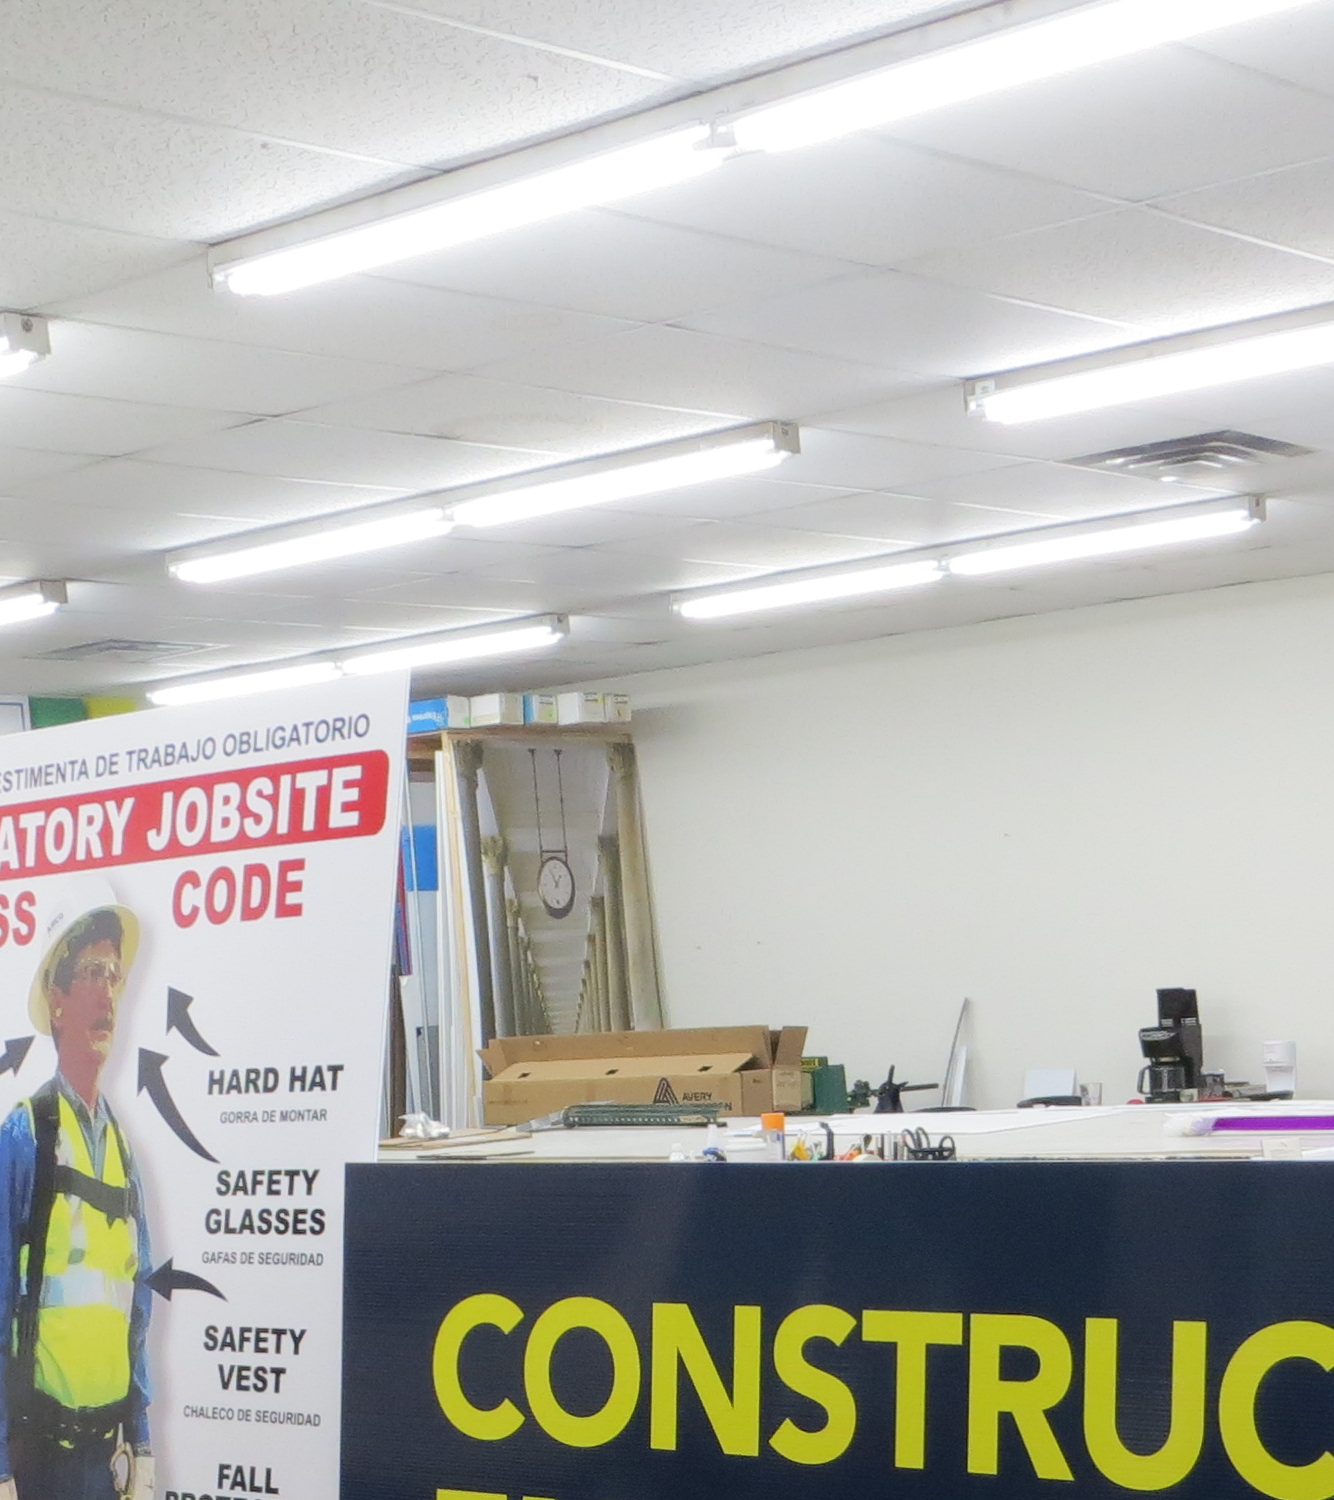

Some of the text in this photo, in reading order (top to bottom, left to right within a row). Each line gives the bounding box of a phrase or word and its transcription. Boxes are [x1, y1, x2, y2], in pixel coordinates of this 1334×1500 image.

[94, 753, 122, 778] DE
[124, 737, 218, 773] TRABAJO
[222, 713, 371, 757] OBLIGATORIO
[146, 764, 364, 853] JOBSITE
[171, 857, 307, 930] CODE
[207, 1064, 345, 1096] HARD HAT
[219, 1108, 328, 1125] GORRA DE MONTAR
[216, 1169, 321, 1197] SAFETY
[205, 1207, 326, 1236] GLASSES
[202, 1250, 324, 1267] GAFAS DE SEGURIDAD
[203, 1324, 307, 1356] SAFETY
[218, 1363, 287, 1394] VEST
[183, 1405, 322, 1428] CHALECO DE SEGURIDAD
[217, 1463, 280, 1495] FALL
